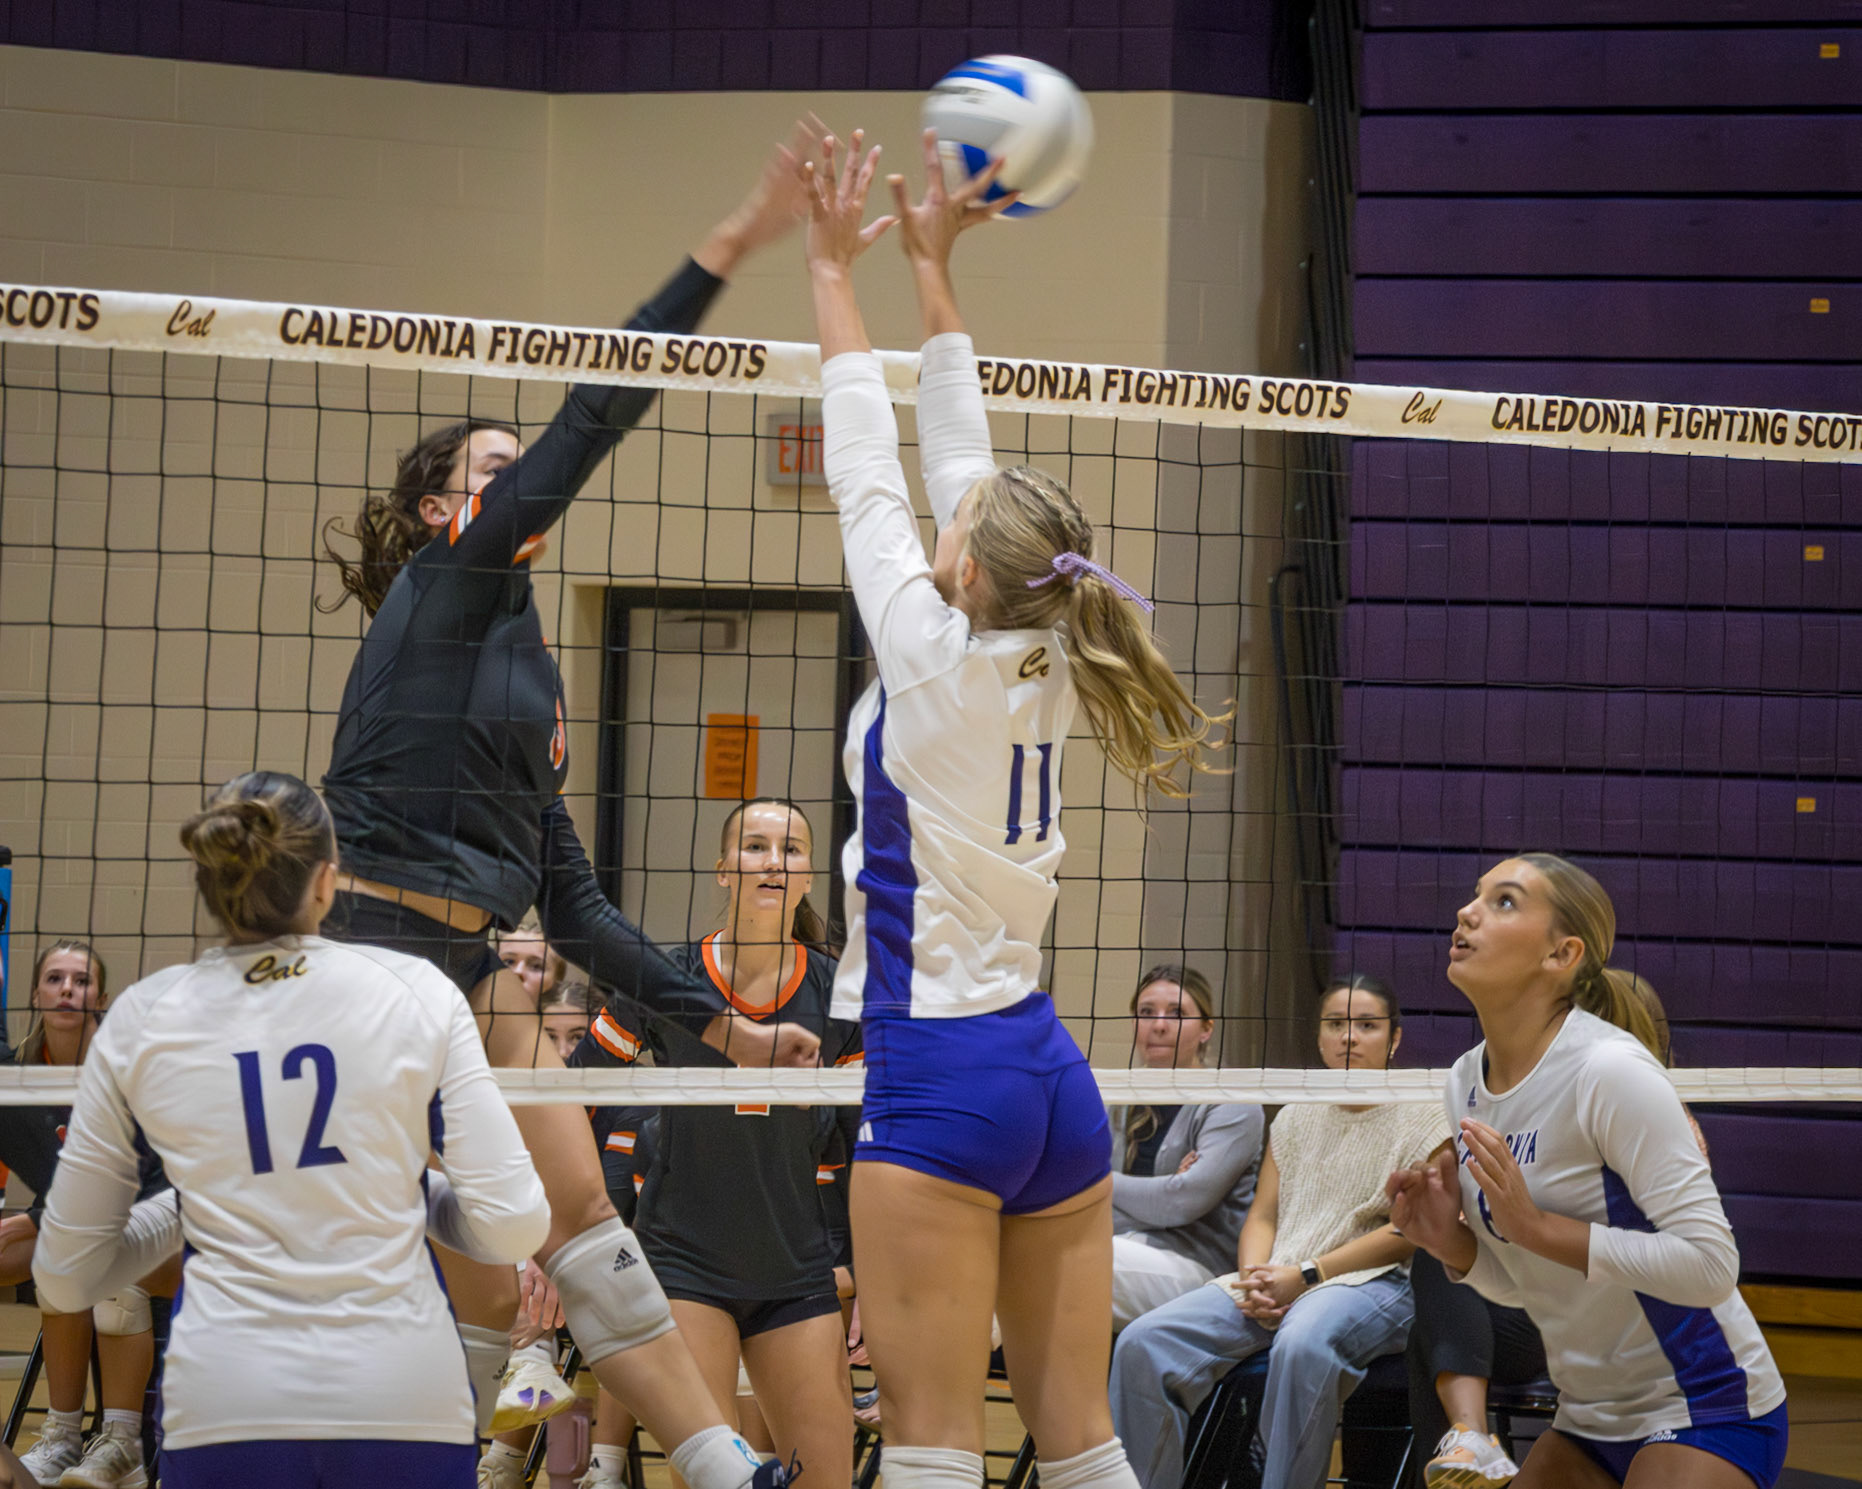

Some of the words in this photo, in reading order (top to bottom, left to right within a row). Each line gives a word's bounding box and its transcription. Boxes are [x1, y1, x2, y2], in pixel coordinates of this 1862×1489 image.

[0, 288, 100, 331] COTS
[165, 299, 216, 338] Cal
[280, 307, 476, 360] CALEDONIA
[487, 325, 654, 373] FIGHTING
[660, 339, 767, 380] SCOTS
[976, 360, 1092, 402] EDONIA
[1101, 367, 1251, 412] FIGHTING
[1257, 380, 1353, 420] SCOTS
[1400, 391, 1443, 426] Cal
[1490, 396, 1646, 438] CALEDONIA
[1654, 405, 1789, 446] FIGHTING
[1794, 414, 1862, 450] SCOT
[1004, 742, 1052, 845] 11
[243, 954, 308, 985] Cal
[230, 1042, 349, 1176] 12
